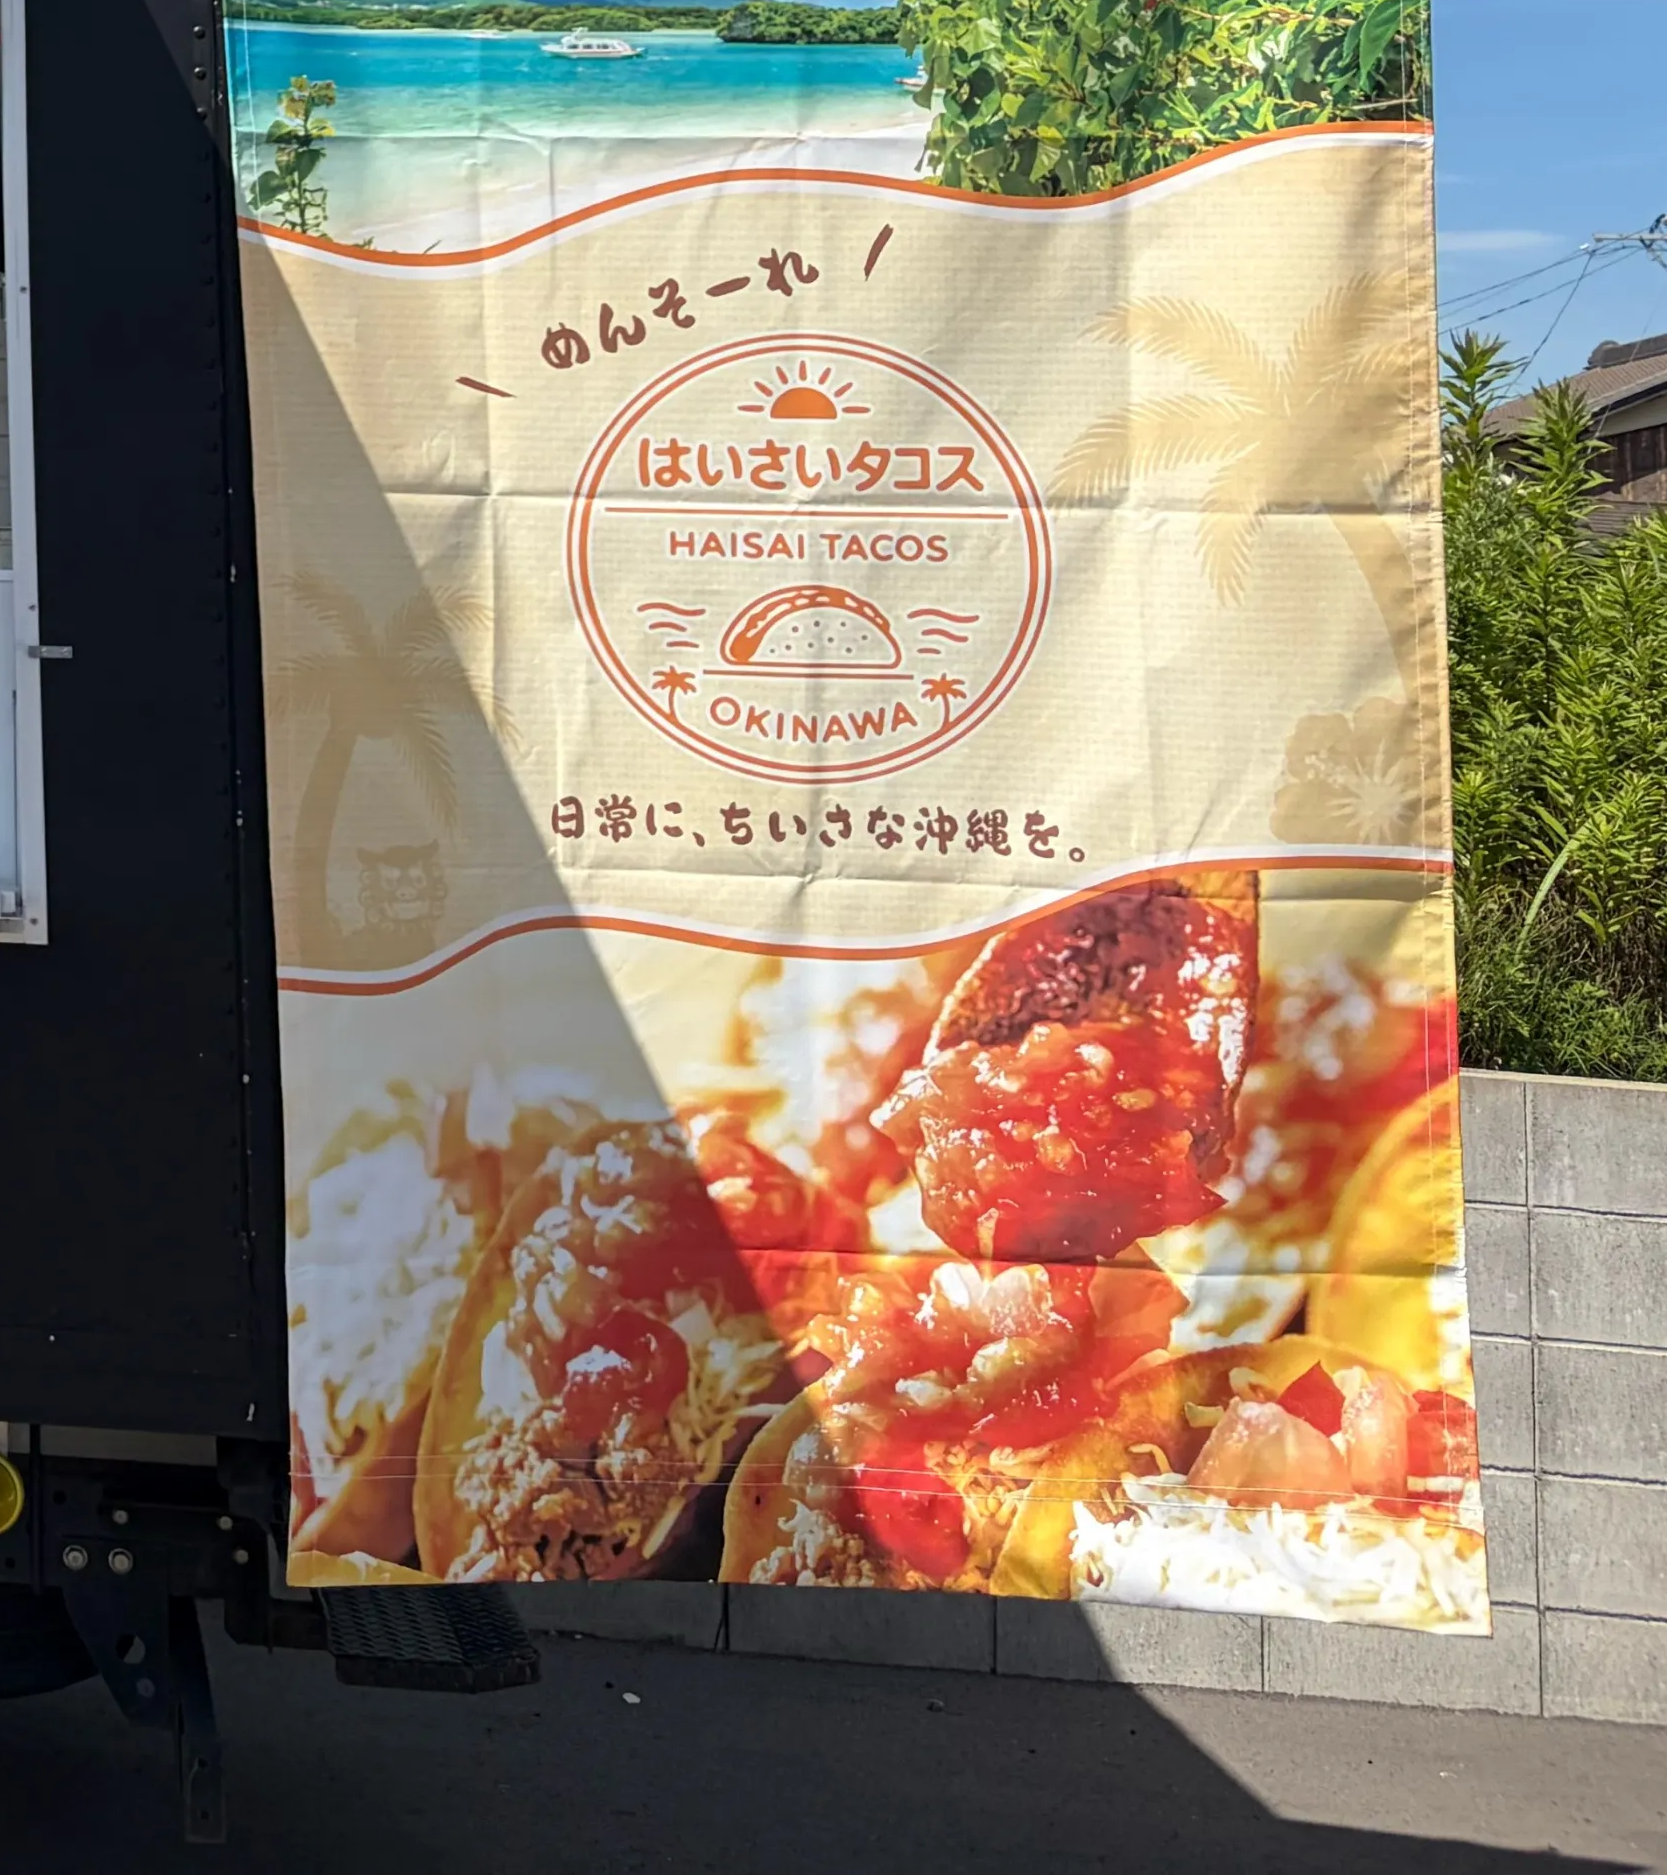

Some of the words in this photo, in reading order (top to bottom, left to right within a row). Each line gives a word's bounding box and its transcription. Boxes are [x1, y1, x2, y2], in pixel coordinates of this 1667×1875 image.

[541, 247, 819, 369] めんそーれ
[638, 437, 985, 493] はいさいタコス
[669, 530, 806, 560] HAISAI
[820, 533, 949, 563] TACOS
[709, 696, 919, 744] OKINAWA
[551, 794, 1086, 864] 日常に、ちいさな沖縄を。
